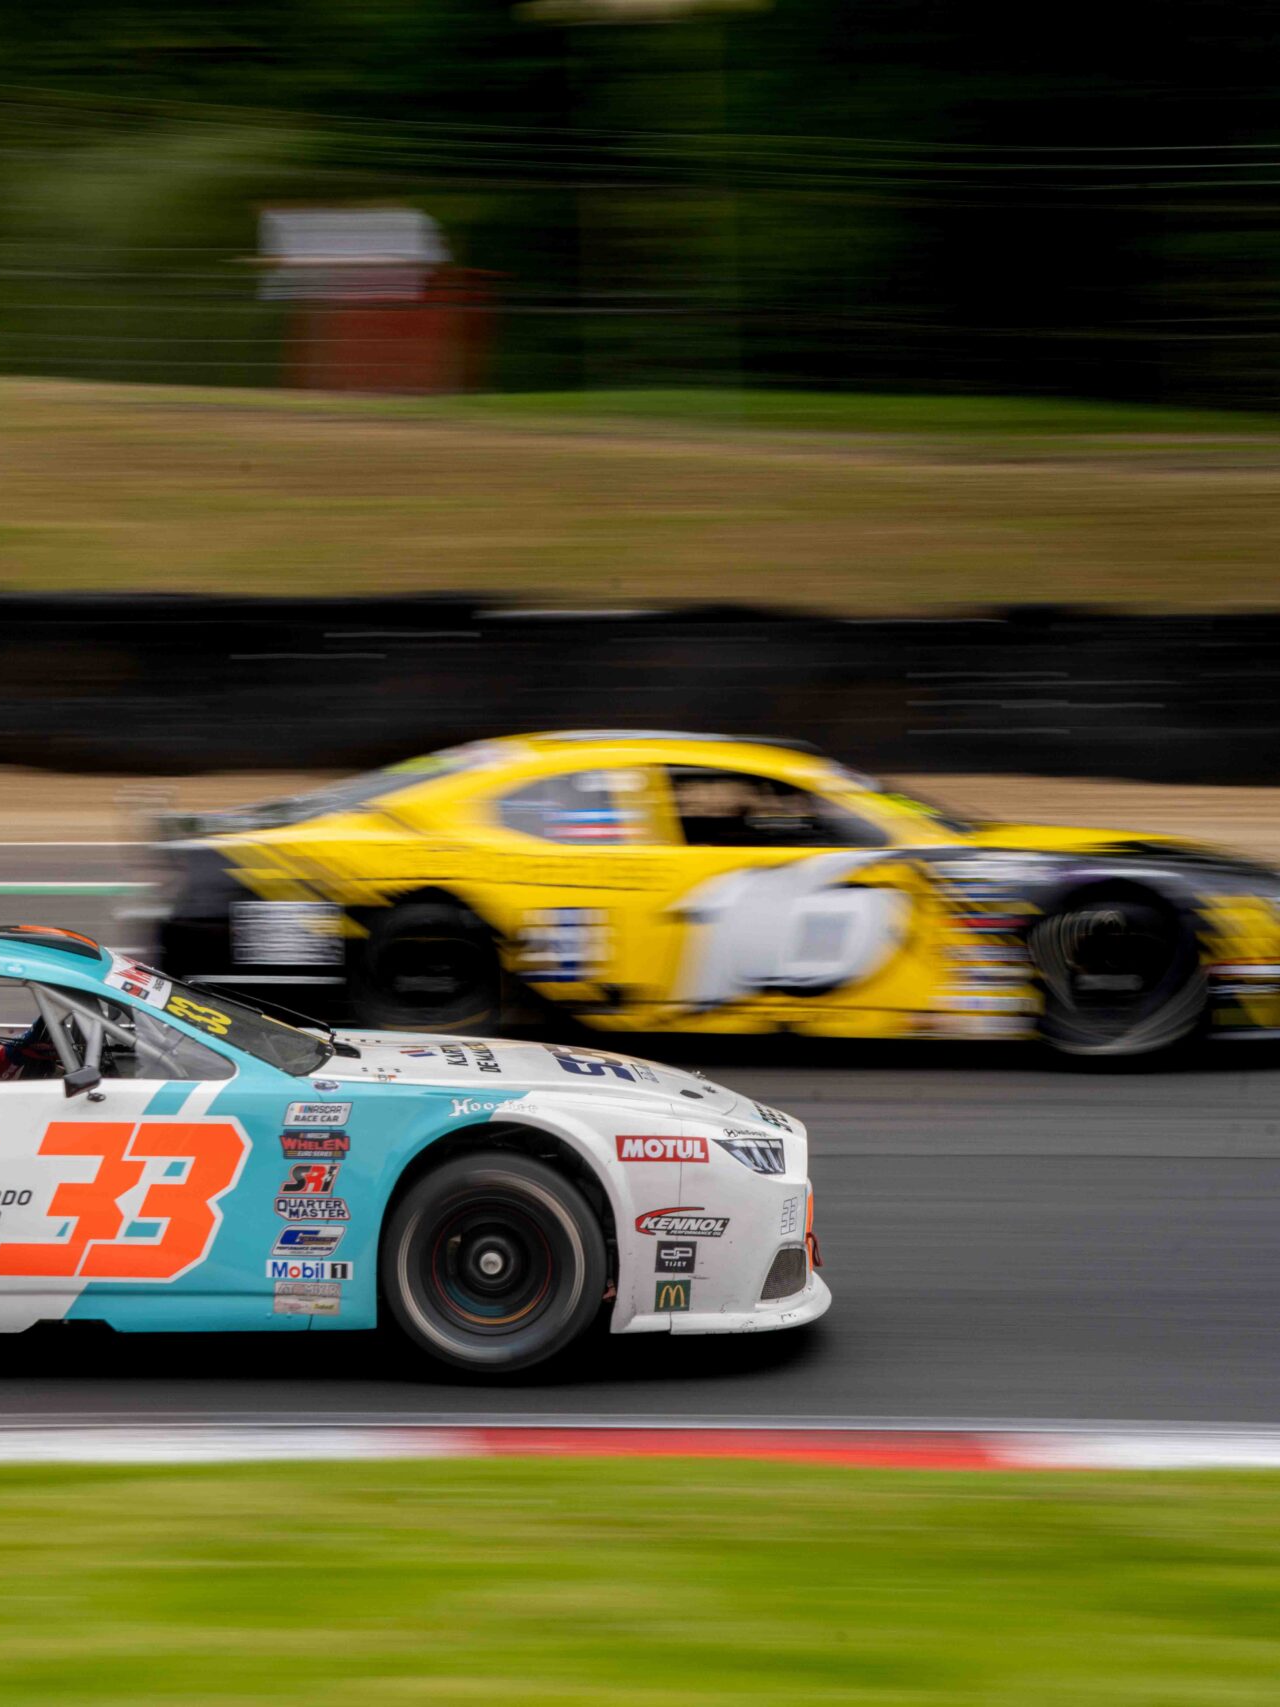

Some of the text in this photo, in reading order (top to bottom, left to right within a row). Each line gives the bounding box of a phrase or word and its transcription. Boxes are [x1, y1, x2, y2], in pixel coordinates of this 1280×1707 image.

[293, 1114, 339, 1122] RACE CAR
[281, 1136, 350, 1151] WHELEN
[621, 1138, 706, 1160] MOTUL
[277, 1199, 343, 1212] QUARTER
[288, 1208, 346, 1218] MASTER
[639, 1215, 725, 1233] KENNOL
[272, 1262, 325, 1280] Mobil
